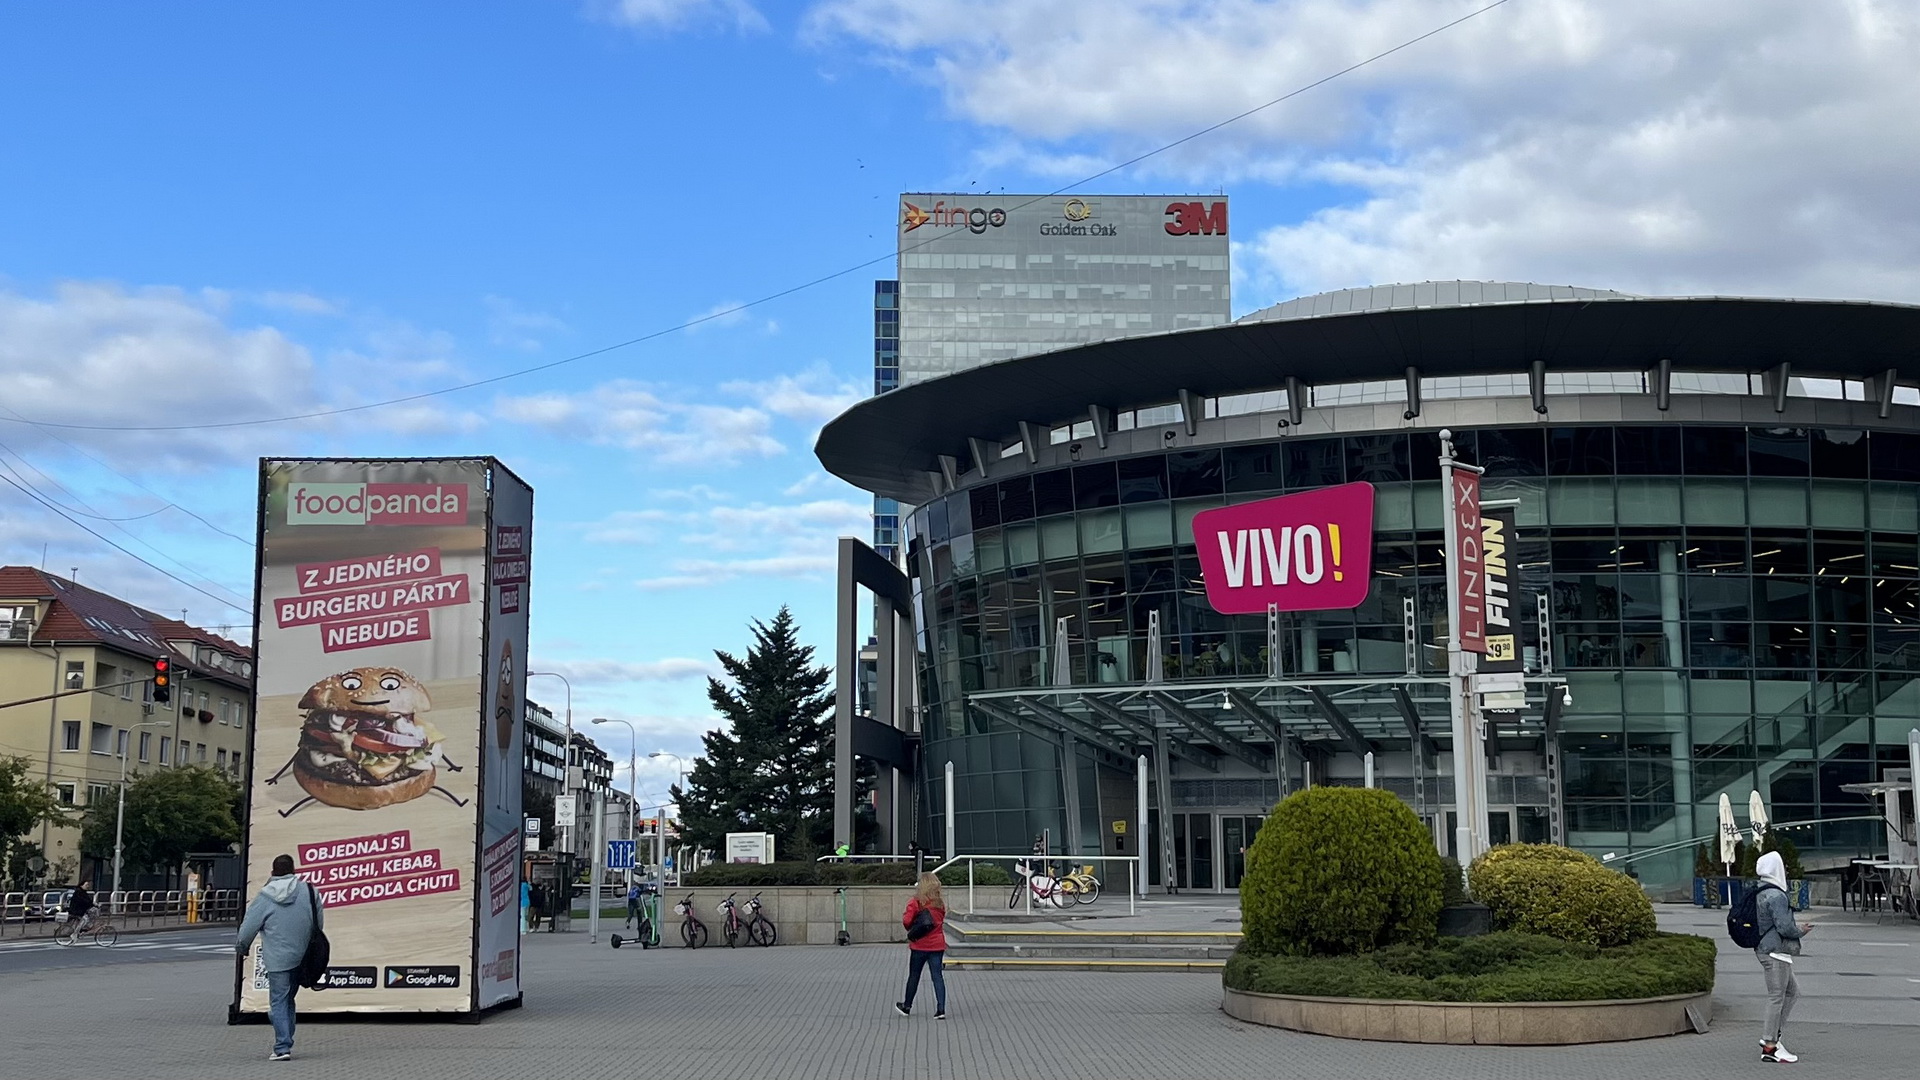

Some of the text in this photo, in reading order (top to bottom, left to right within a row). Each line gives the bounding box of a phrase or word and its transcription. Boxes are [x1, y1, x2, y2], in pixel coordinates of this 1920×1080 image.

[934, 200, 1006, 234] fingo
[1039, 222, 1117, 236] Golden Oak
[1164, 202, 1226, 235] 3M
[294, 486, 459, 522] foodpanda
[303, 554, 431, 589] Z JEDNÉHO
[1217, 522, 1343, 588] VIVO!
[1459, 481, 1480, 639] LINDEX
[1480, 517, 1511, 628] FITINN
[280, 579, 462, 622] BURGERU PÁRTY
[327, 617, 419, 647] NEBUDE
[305, 836, 406, 862] OBJEDNAJ SI
[328, 862, 379, 881] SUSHI,
[382, 855, 438, 874] KEBAB,
[319, 873, 455, 905] VEK PODĽA CHUTI
[328, 975, 373, 986] App Store
[406, 974, 456, 987] Google Play
